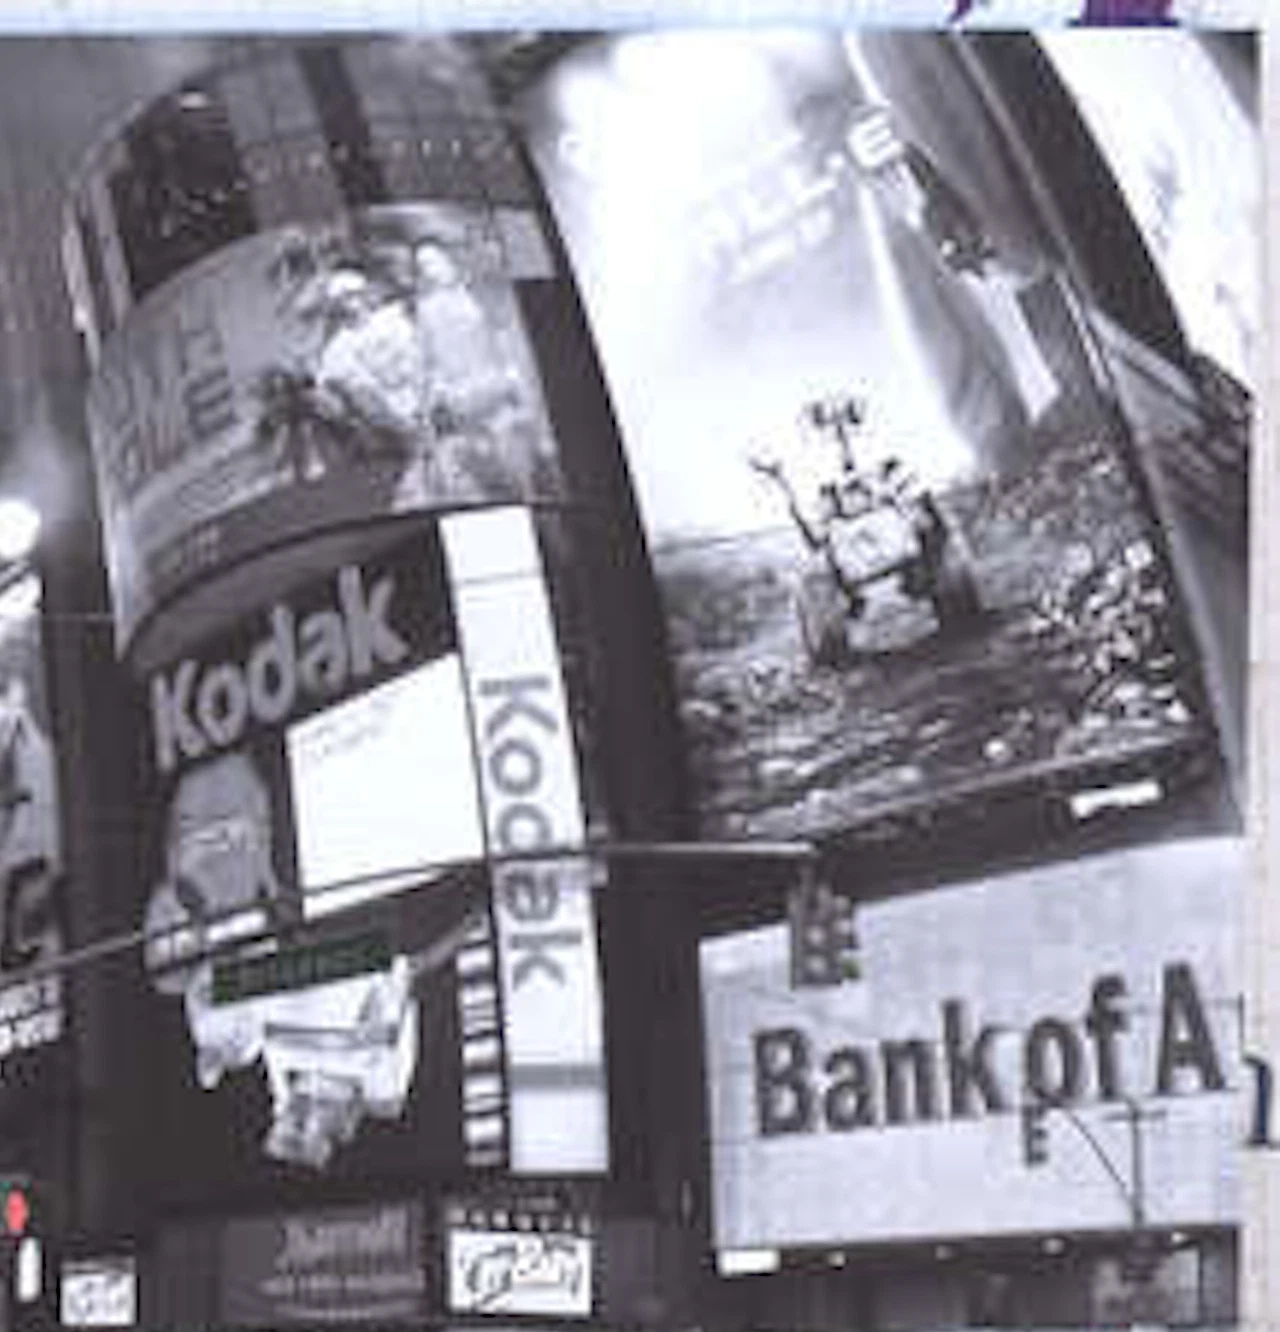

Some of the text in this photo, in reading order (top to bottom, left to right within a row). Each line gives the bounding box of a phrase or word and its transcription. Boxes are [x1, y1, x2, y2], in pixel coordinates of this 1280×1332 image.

[152, 565, 409, 771] Kodak
[478, 675, 582, 989] Kodak
[752, 1000, 1004, 1138] Bank
[1026, 974, 1128, 1102] of
